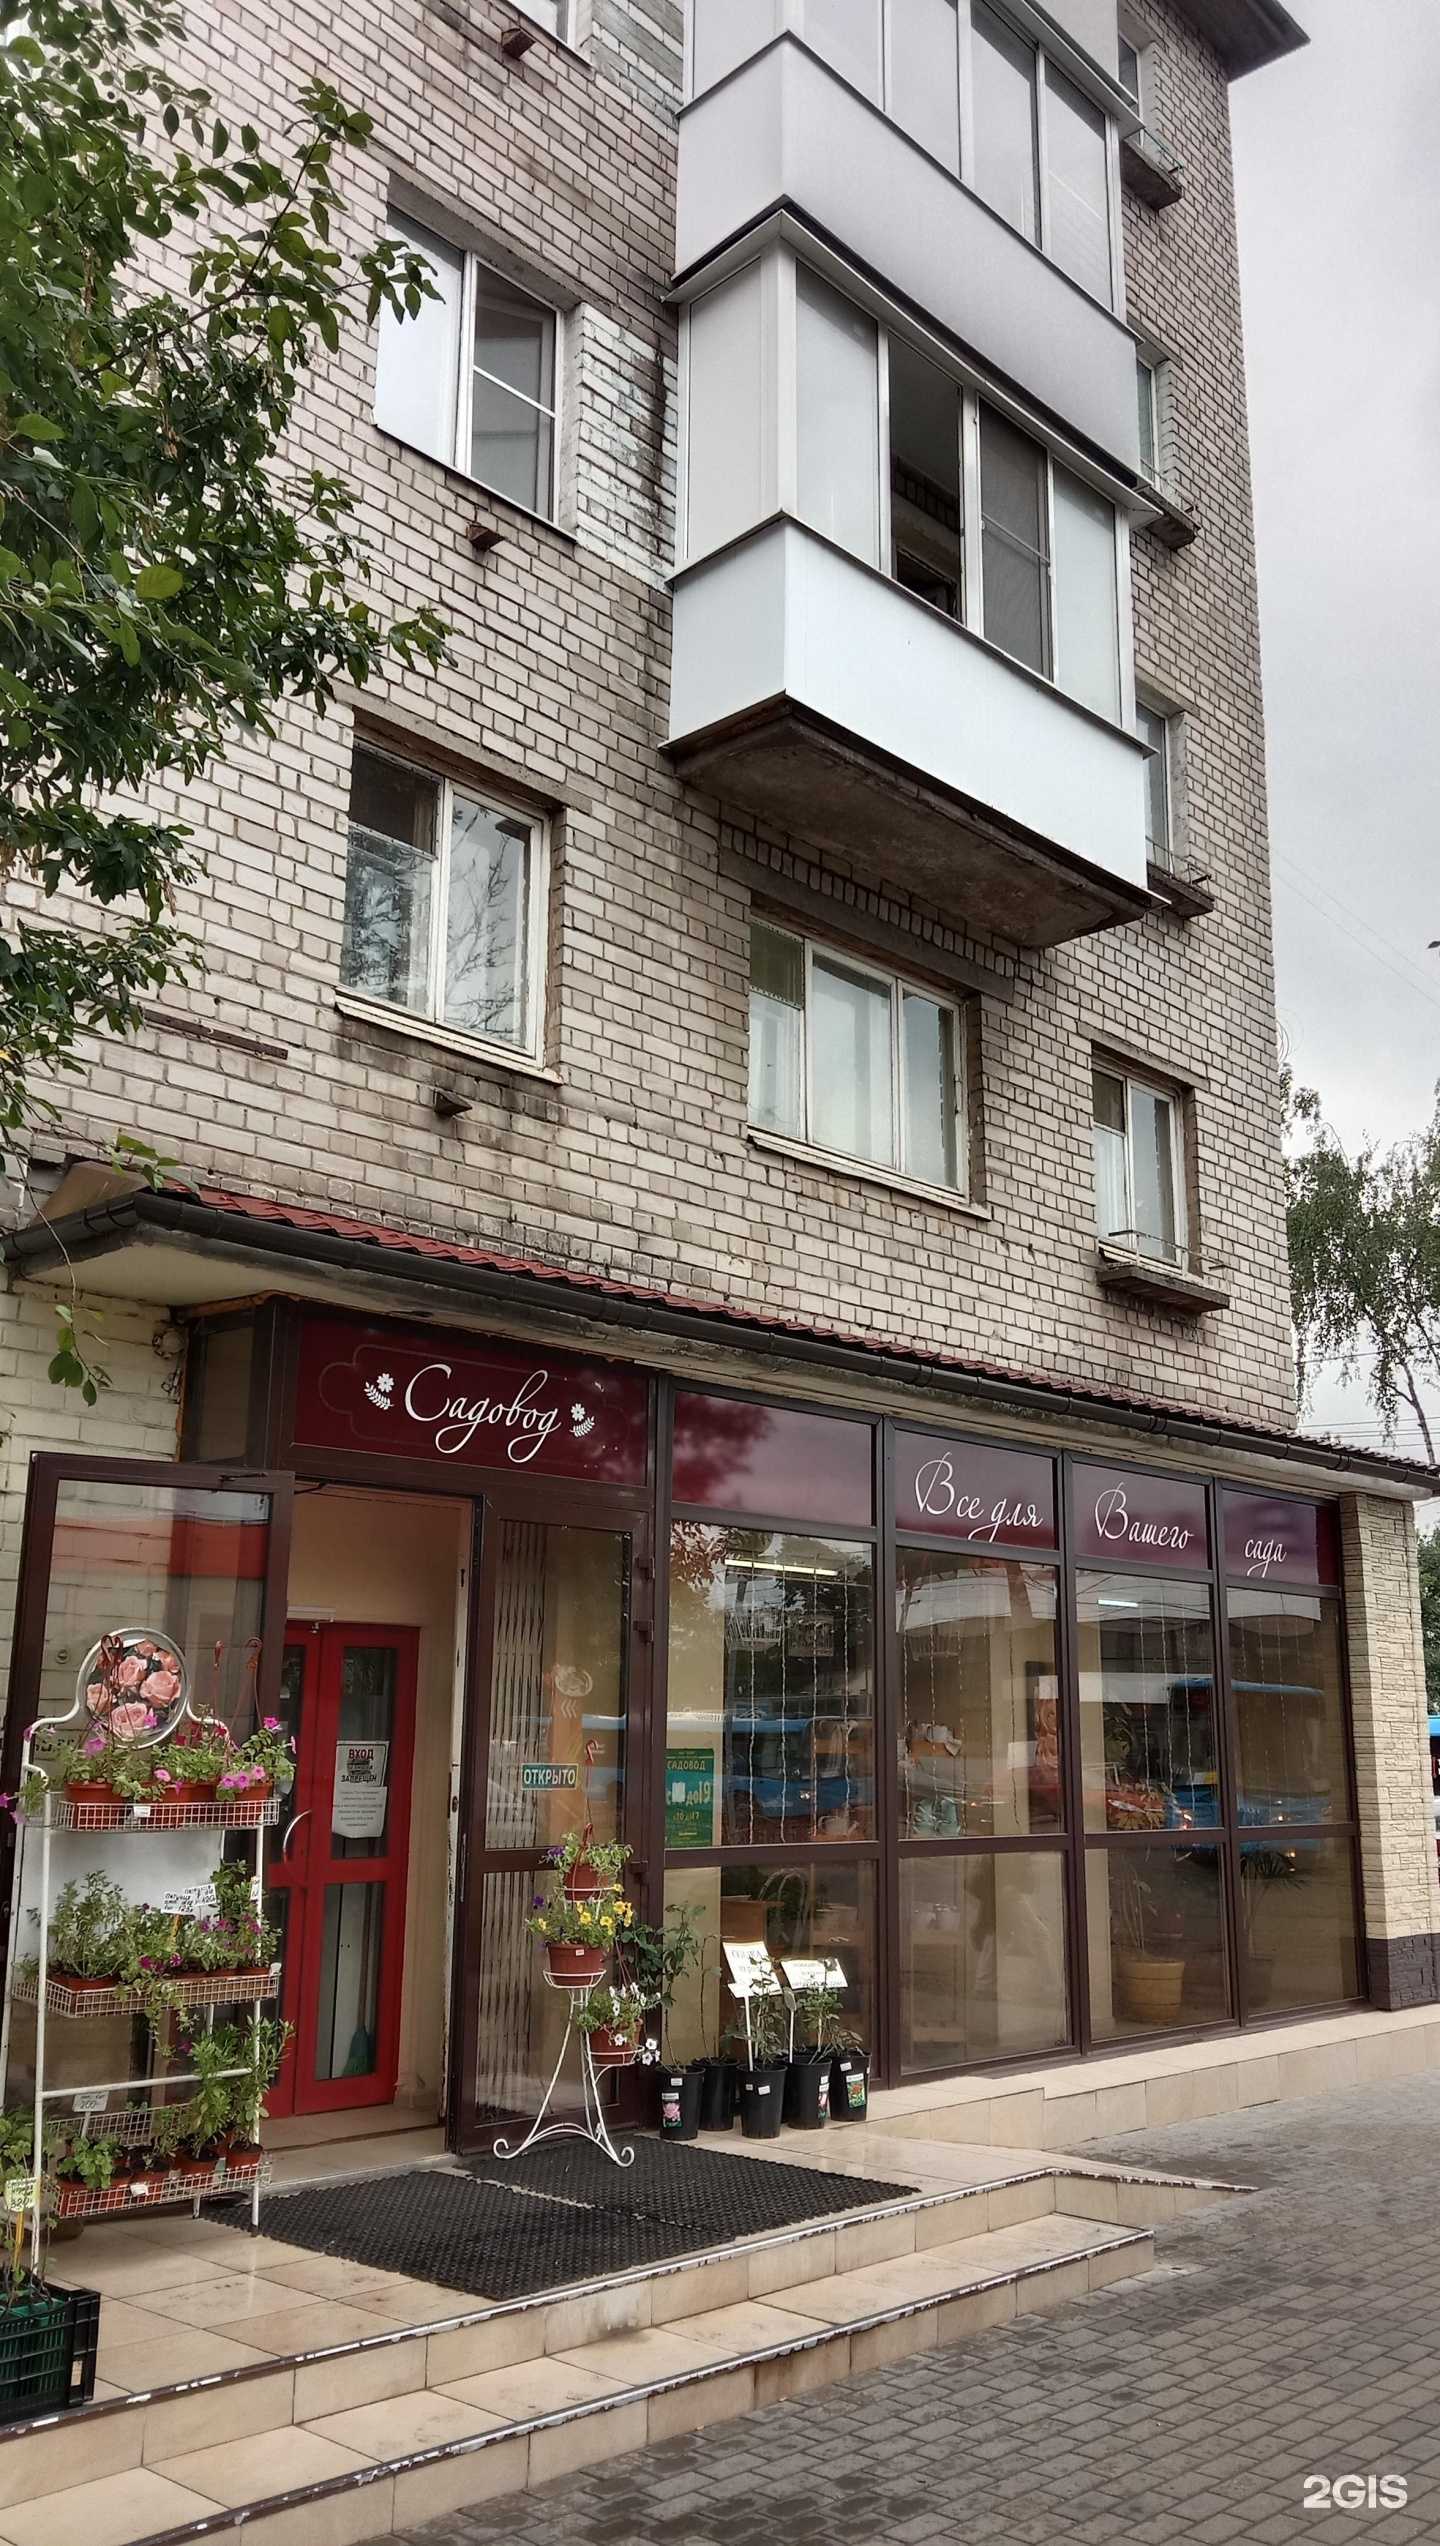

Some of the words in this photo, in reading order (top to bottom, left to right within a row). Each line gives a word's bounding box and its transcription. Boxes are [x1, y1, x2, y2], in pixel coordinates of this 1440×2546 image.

[404, 1364, 561, 1463] Садовод
[914, 1451, 984, 1516] Все
[967, 1497, 1044, 1545] для
[1094, 1481, 1195, 1551] Вашего
[1244, 1535, 1288, 1578] сада
[348, 1749, 374, 1760] ВХОД
[667, 1760, 705, 1771] САДОВОД
[523, 1768, 576, 1786] ОТКРЫТО
